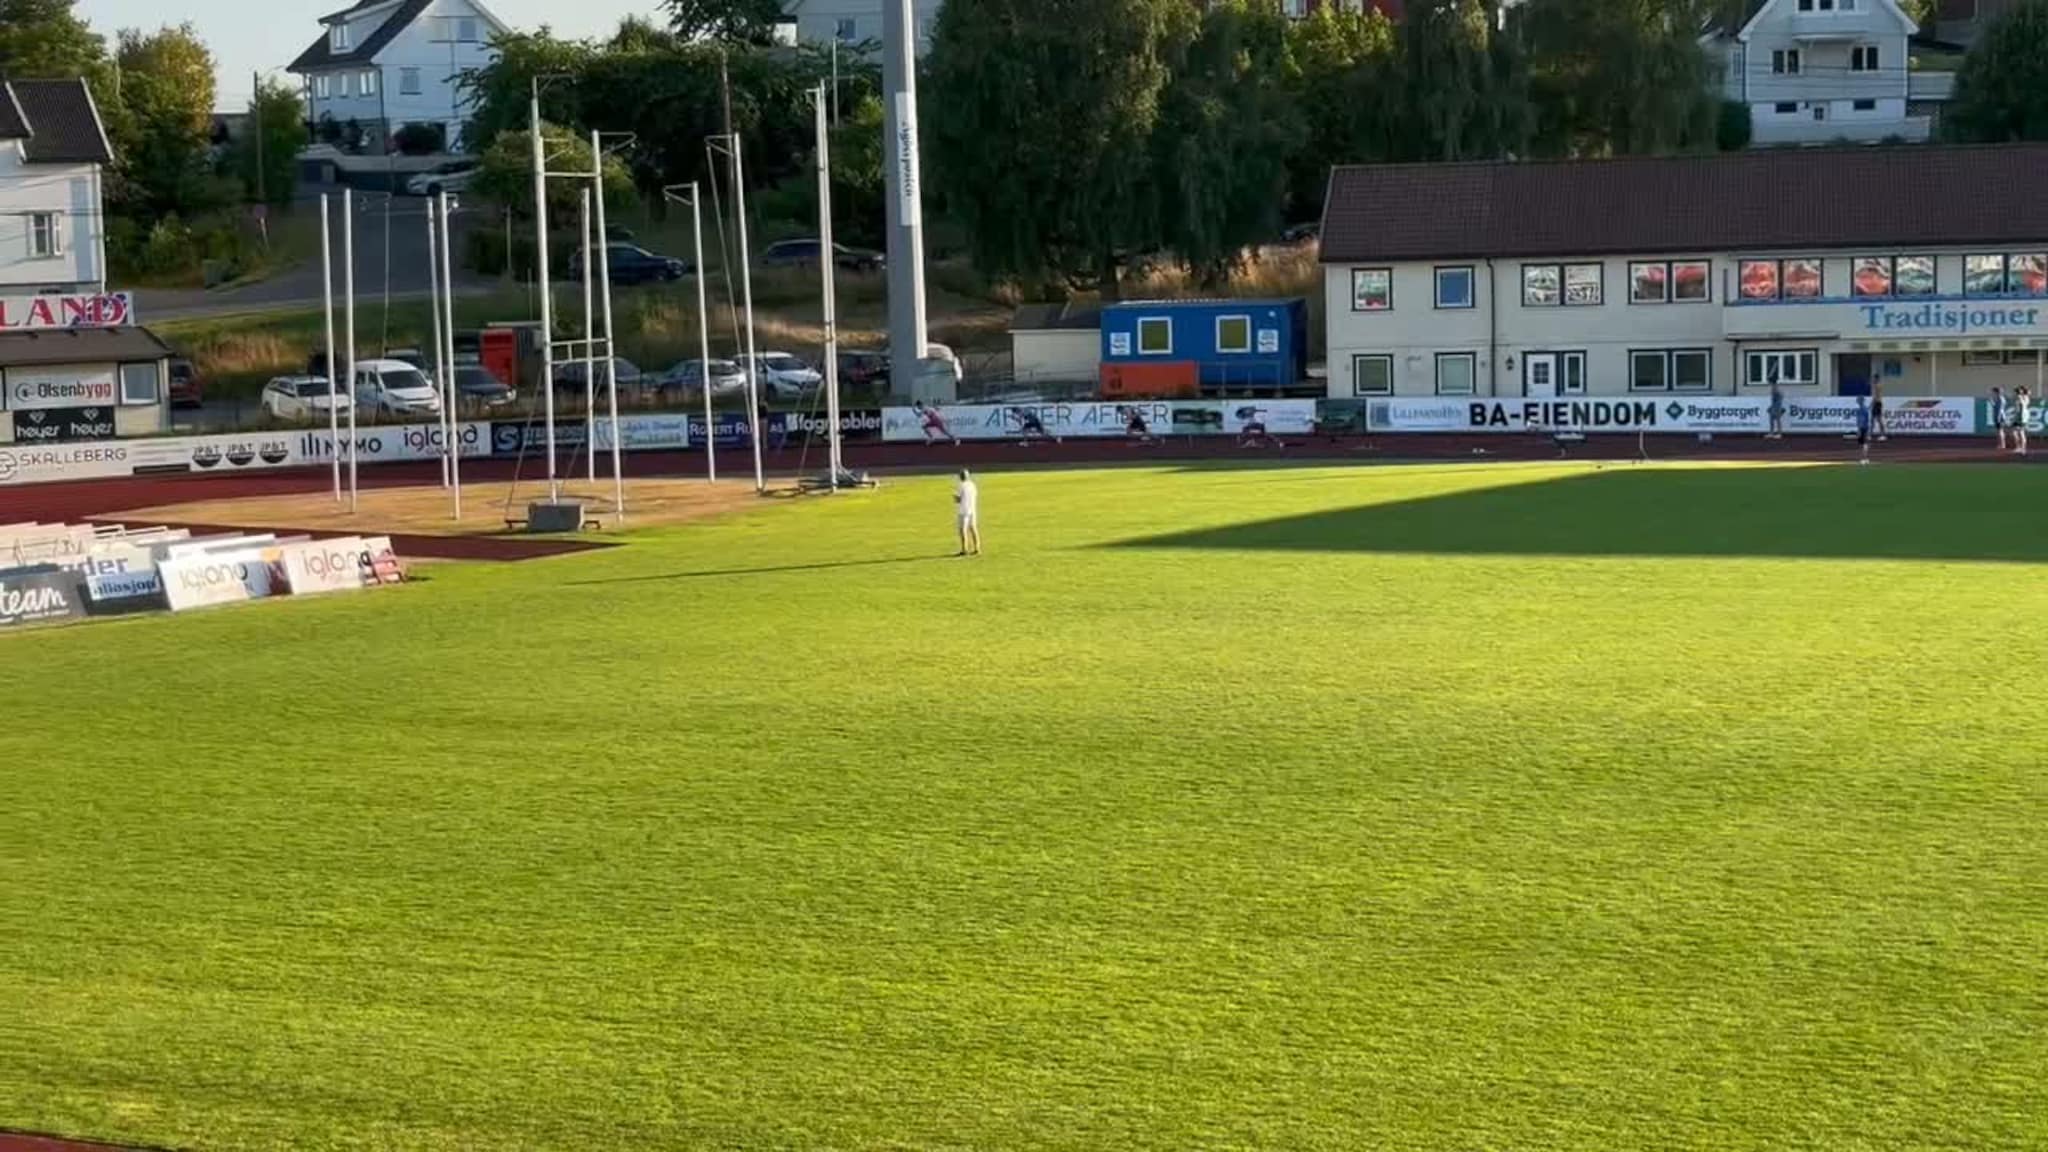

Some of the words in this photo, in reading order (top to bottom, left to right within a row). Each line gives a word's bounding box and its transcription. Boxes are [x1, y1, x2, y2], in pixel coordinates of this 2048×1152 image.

[1860, 304, 2039, 333] Tradisjoner
[38, 381, 112, 399] Olsenbygg
[1469, 402, 1656, 427] BA-EIENDOM
[1687, 404, 1760, 420] Byggtorget
[1789, 404, 1858, 420] Byggtorge
[325, 437, 382, 454] NYMO
[19, 448, 127, 467] SKALLEBERG
